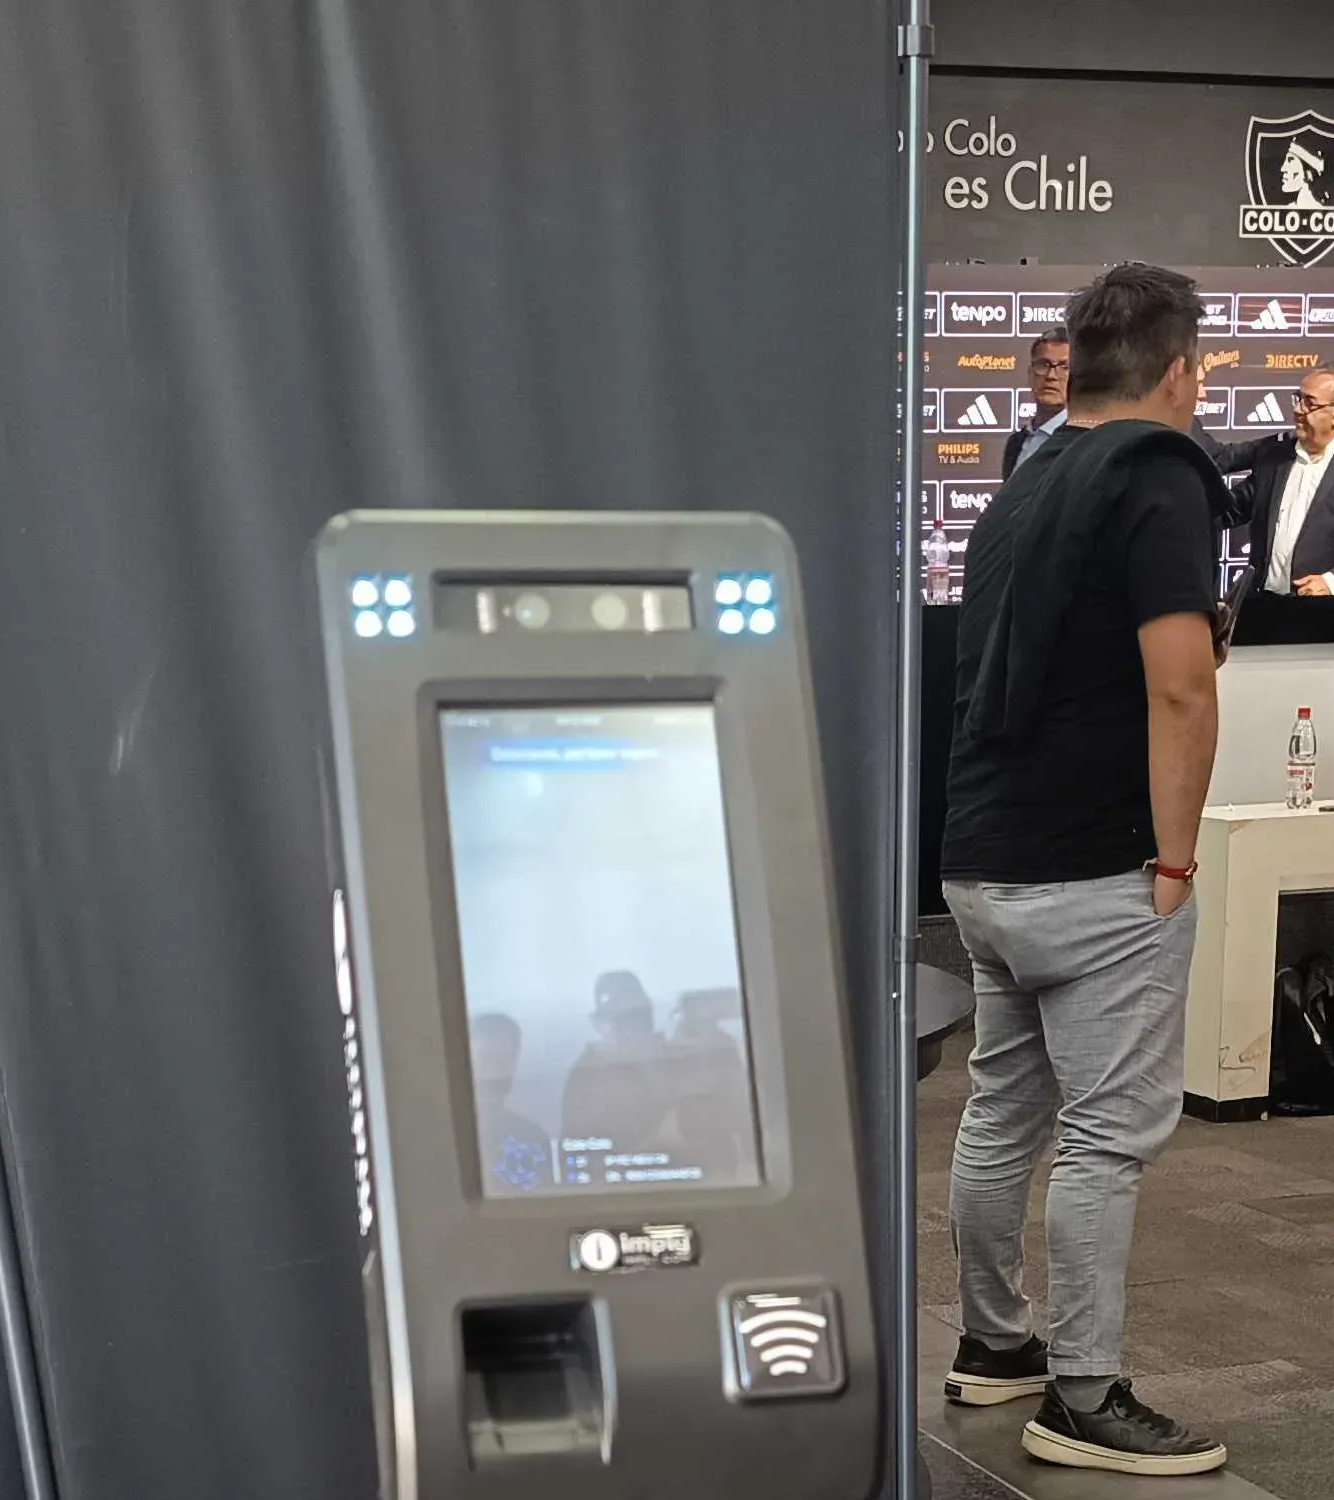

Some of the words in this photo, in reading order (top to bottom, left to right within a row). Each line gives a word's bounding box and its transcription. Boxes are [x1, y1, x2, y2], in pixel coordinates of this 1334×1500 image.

[944, 115, 1017, 157] Colo
[944, 176, 989, 209] es
[1005, 154, 1114, 213] Chile
[1022, 306, 1065, 322] DIREC
[1265, 354, 1319, 368] DIRECTV
[937, 443, 980, 455] PHILIPS
[938, 455, 949, 464] TV
[957, 455, 980, 464] Audio
[949, 489, 993, 513] tenp
